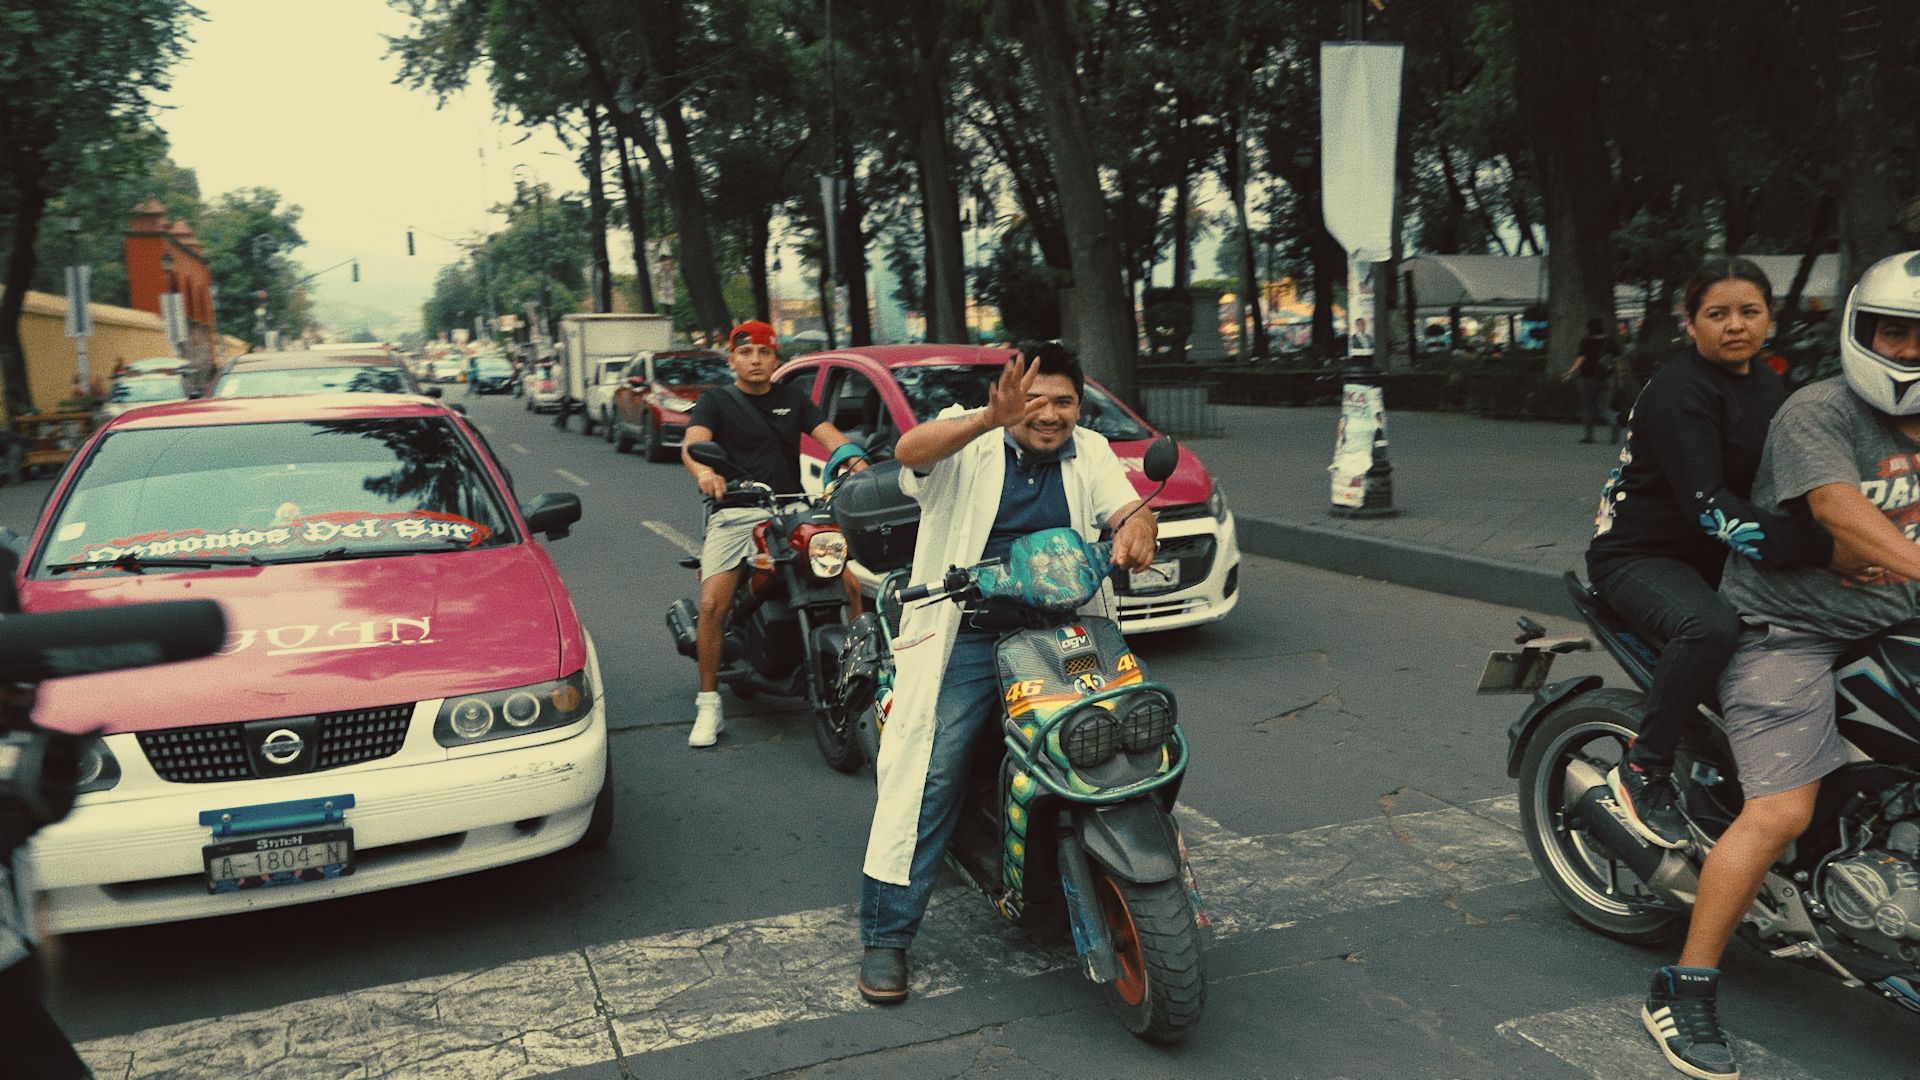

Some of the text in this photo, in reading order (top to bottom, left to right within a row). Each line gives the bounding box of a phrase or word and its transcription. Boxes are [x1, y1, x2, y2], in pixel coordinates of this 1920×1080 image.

[304, 518, 383, 542] Del
[391, 517, 475, 540] Sur
[1061, 634, 1086, 649] agv
[1116, 653, 1138, 672] 4
[1006, 678, 1045, 702] 46
[221, 843, 340, 878] A-1804-N
